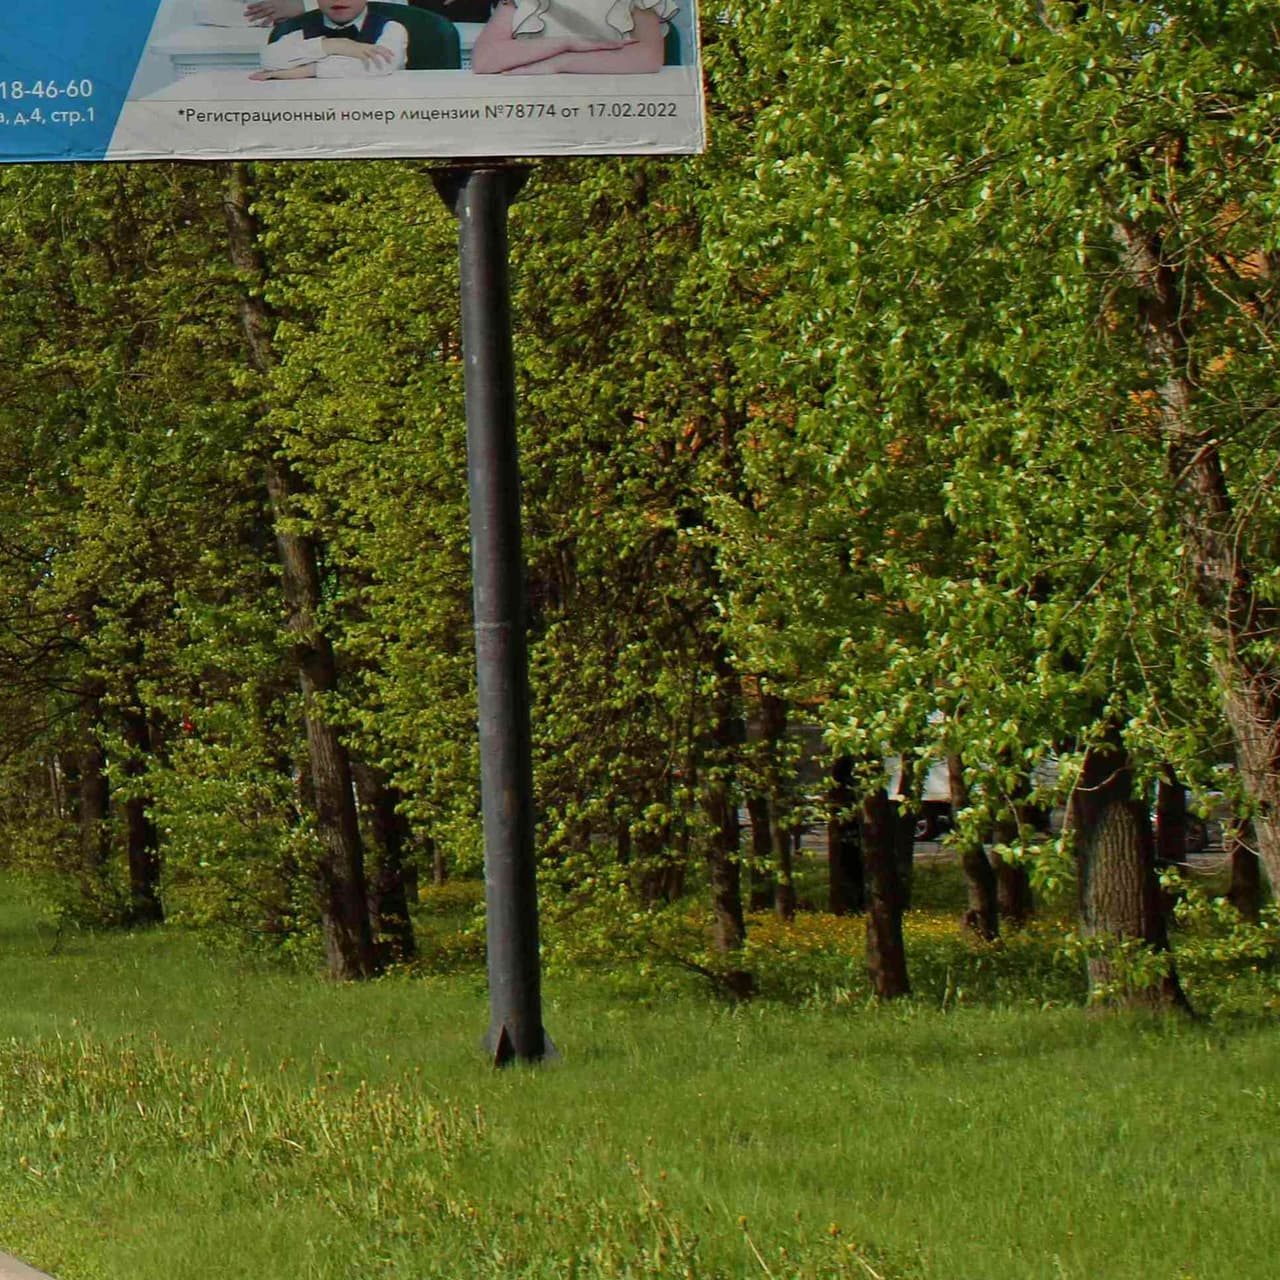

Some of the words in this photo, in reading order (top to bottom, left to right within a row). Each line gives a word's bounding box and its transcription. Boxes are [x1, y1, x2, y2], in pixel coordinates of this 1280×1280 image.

[14, 107, 46, 125] д.4,
[51, 107, 95, 127] стр.1
[341, 110, 396, 125] номер
[400, 108, 481, 123] лицензии
[485, 104, 557, 120] №78774
[561, 107, 580, 119] от
[587, 103, 678, 119] 17.02.2022
